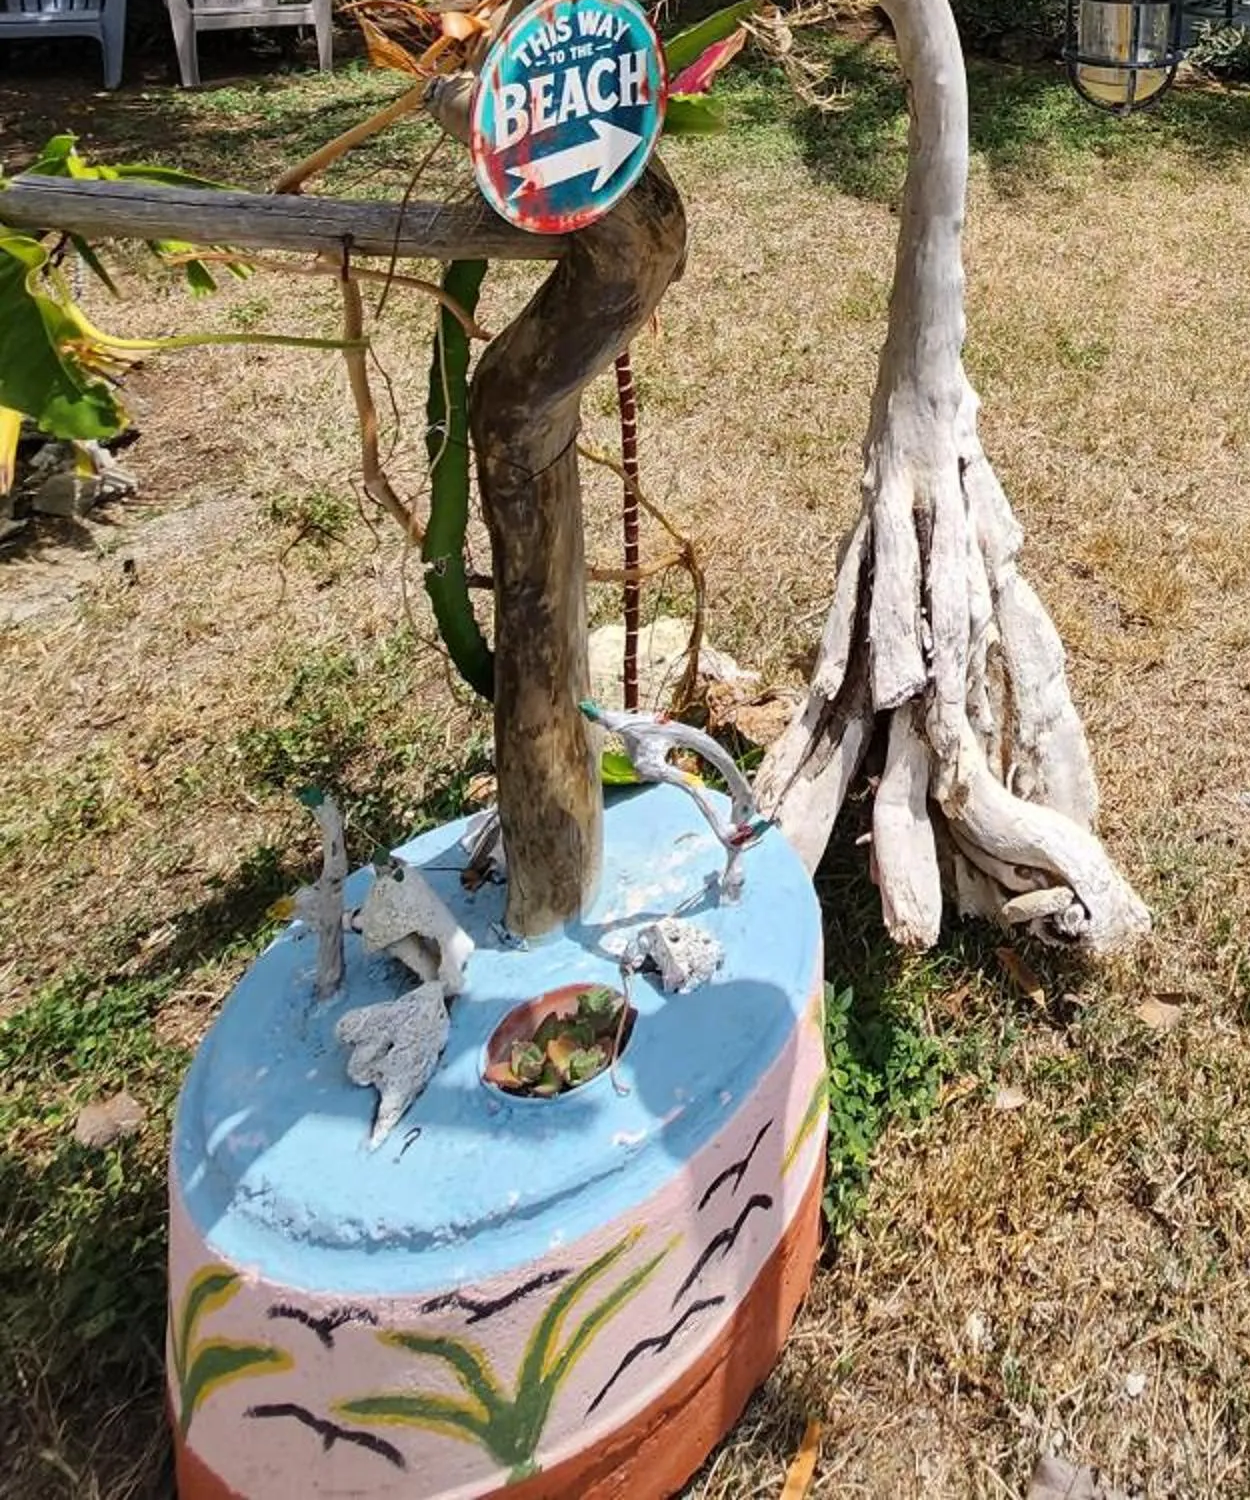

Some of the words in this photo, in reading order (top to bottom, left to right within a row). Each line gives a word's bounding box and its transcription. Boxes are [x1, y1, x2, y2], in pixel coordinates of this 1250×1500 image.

[511, 14, 573, 69] THIS
[577, 11, 631, 43] WAY
[549, 50, 566, 66] TO
[569, 43, 595, 61] THE
[492, 48, 652, 155] BEACH
